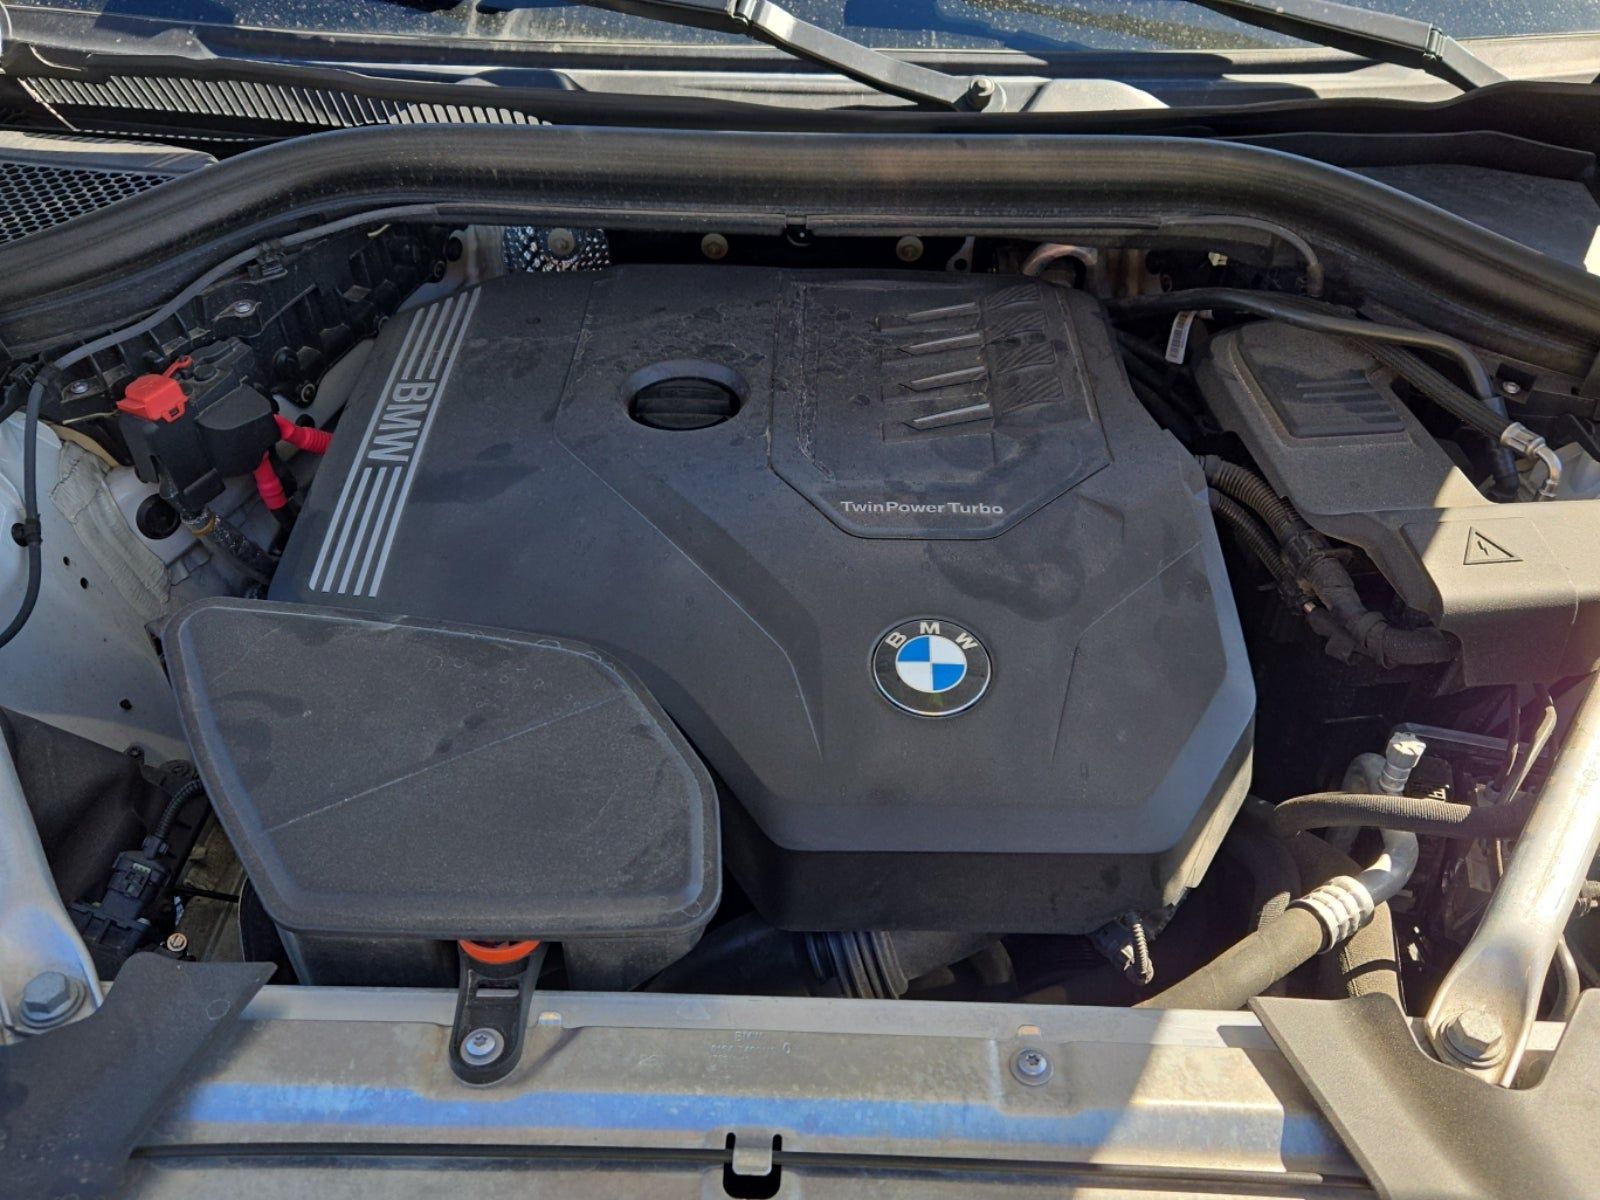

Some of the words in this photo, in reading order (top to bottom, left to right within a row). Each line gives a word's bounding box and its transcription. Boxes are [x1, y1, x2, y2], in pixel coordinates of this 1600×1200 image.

[367, 382, 436, 462] BMW
[840, 501, 945, 513] TwinPower
[947, 502, 1004, 515] Turbo
[885, 621, 978, 650] BMW
